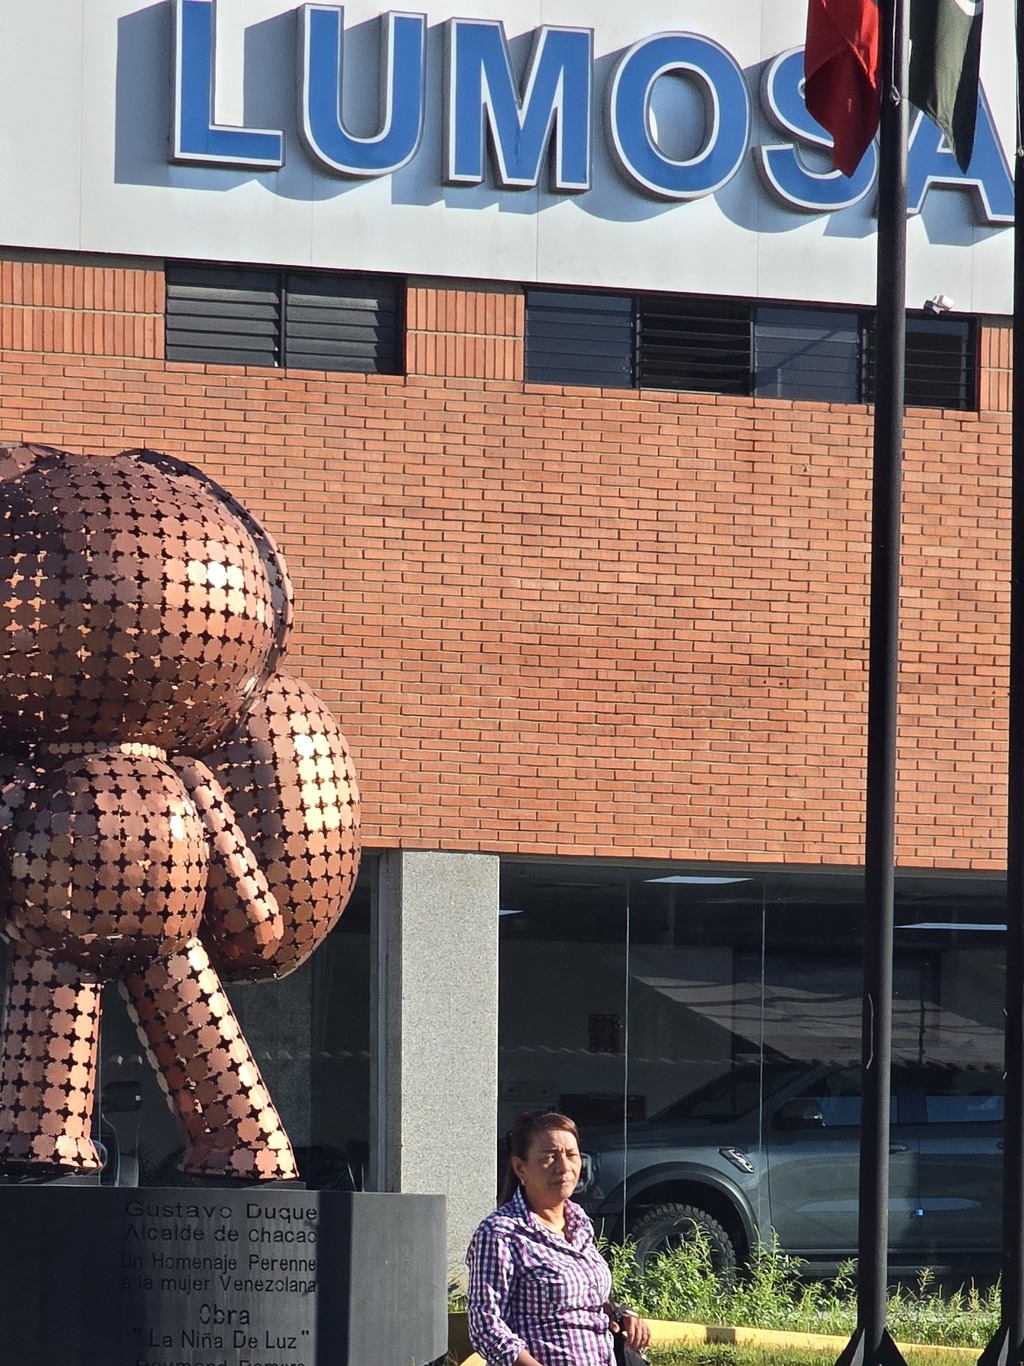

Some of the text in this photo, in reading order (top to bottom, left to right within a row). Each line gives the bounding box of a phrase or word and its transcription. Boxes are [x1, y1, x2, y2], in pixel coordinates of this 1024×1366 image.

[171, 0, 1015, 224] LUMOSA
[125, 1201, 317, 1224] Gustavo Duque
[125, 1225, 205, 1241] Alcalde
[214, 1225, 239, 1242] de
[121, 1253, 315, 1274] Un Homenaje Perenne
[122, 1275, 316, 1295] a la mujer Venezolana
[200, 1304, 249, 1325] Obra
[182, 1329, 223, 1348] Niña
[233, 1331, 258, 1348] De
